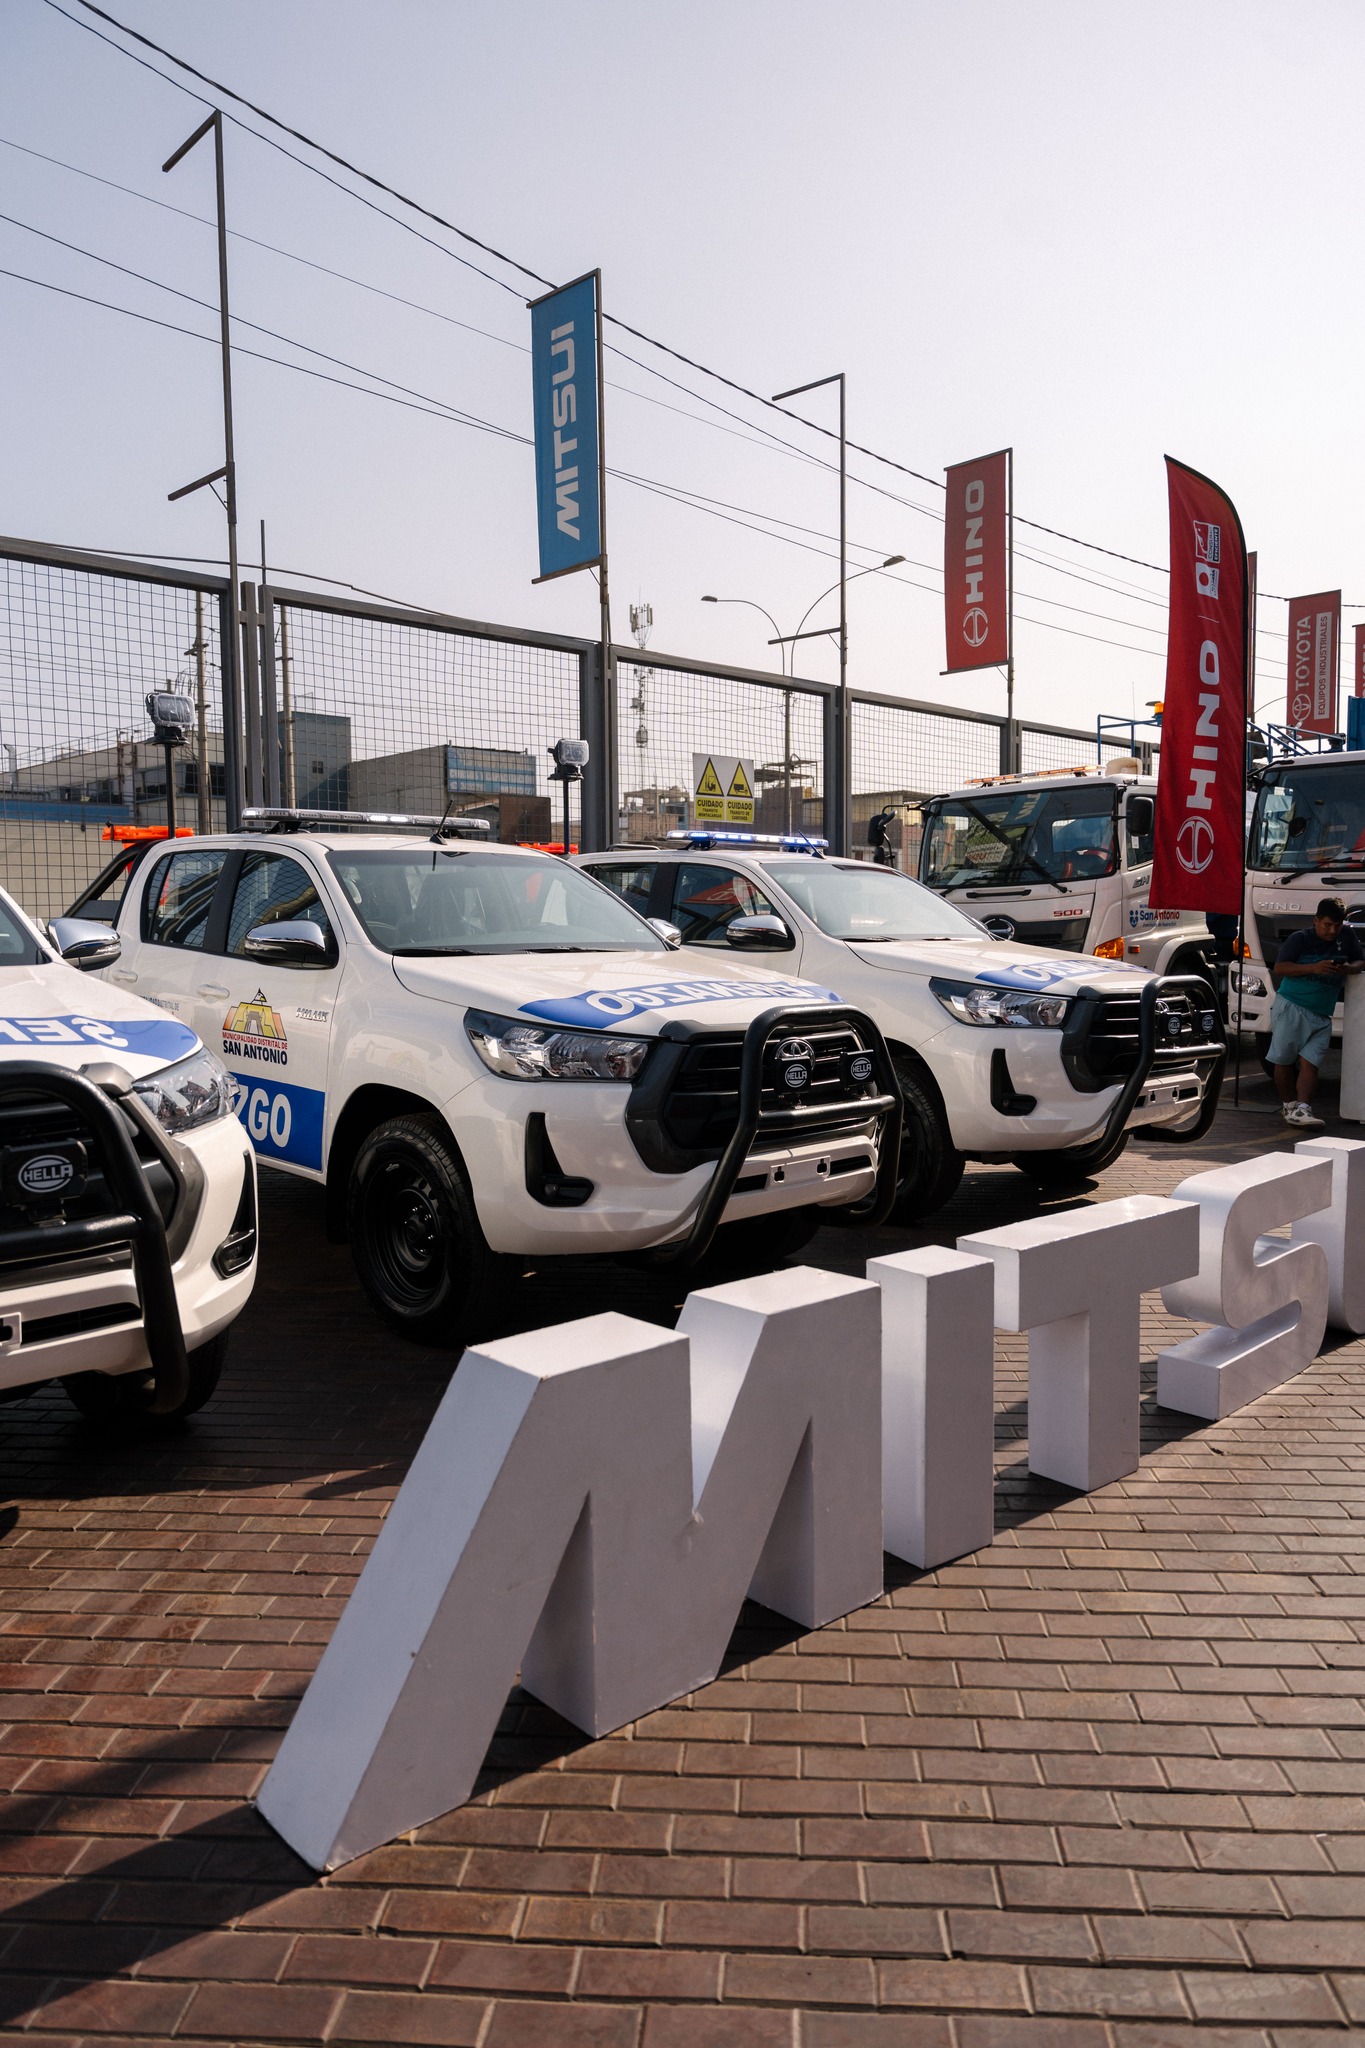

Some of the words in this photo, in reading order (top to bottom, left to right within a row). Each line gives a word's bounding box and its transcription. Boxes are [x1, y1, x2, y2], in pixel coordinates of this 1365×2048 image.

[550, 319, 581, 541] MITSUI
[965, 479, 985, 604] HINO
[1295, 614, 1312, 692] TOYOTA
[1319, 614, 1328, 676] INDUSTRIALES
[1317, 677, 1327, 716] EQUIPOS
[1185, 639, 1220, 810] HINO
[697, 799, 723, 808] CUIDADO
[727, 801, 752, 811] CUIDADO
[1053, 909, 1083, 918] 500
[1257, 901, 1302, 912] HINO
[221, 1031, 257, 1045] MUNICIPALIDAD
[256, 1037, 281, 1049] DISTRITAL
[281, 1042, 288, 1050] DE
[222, 1040, 242, 1058] SAN
[243, 1043, 288, 1066] ANTONIO
[786, 1070, 808, 1081] HELLA
[851, 1063, 872, 1074] HELLA
[23, 1162, 74, 1182] HELLA
